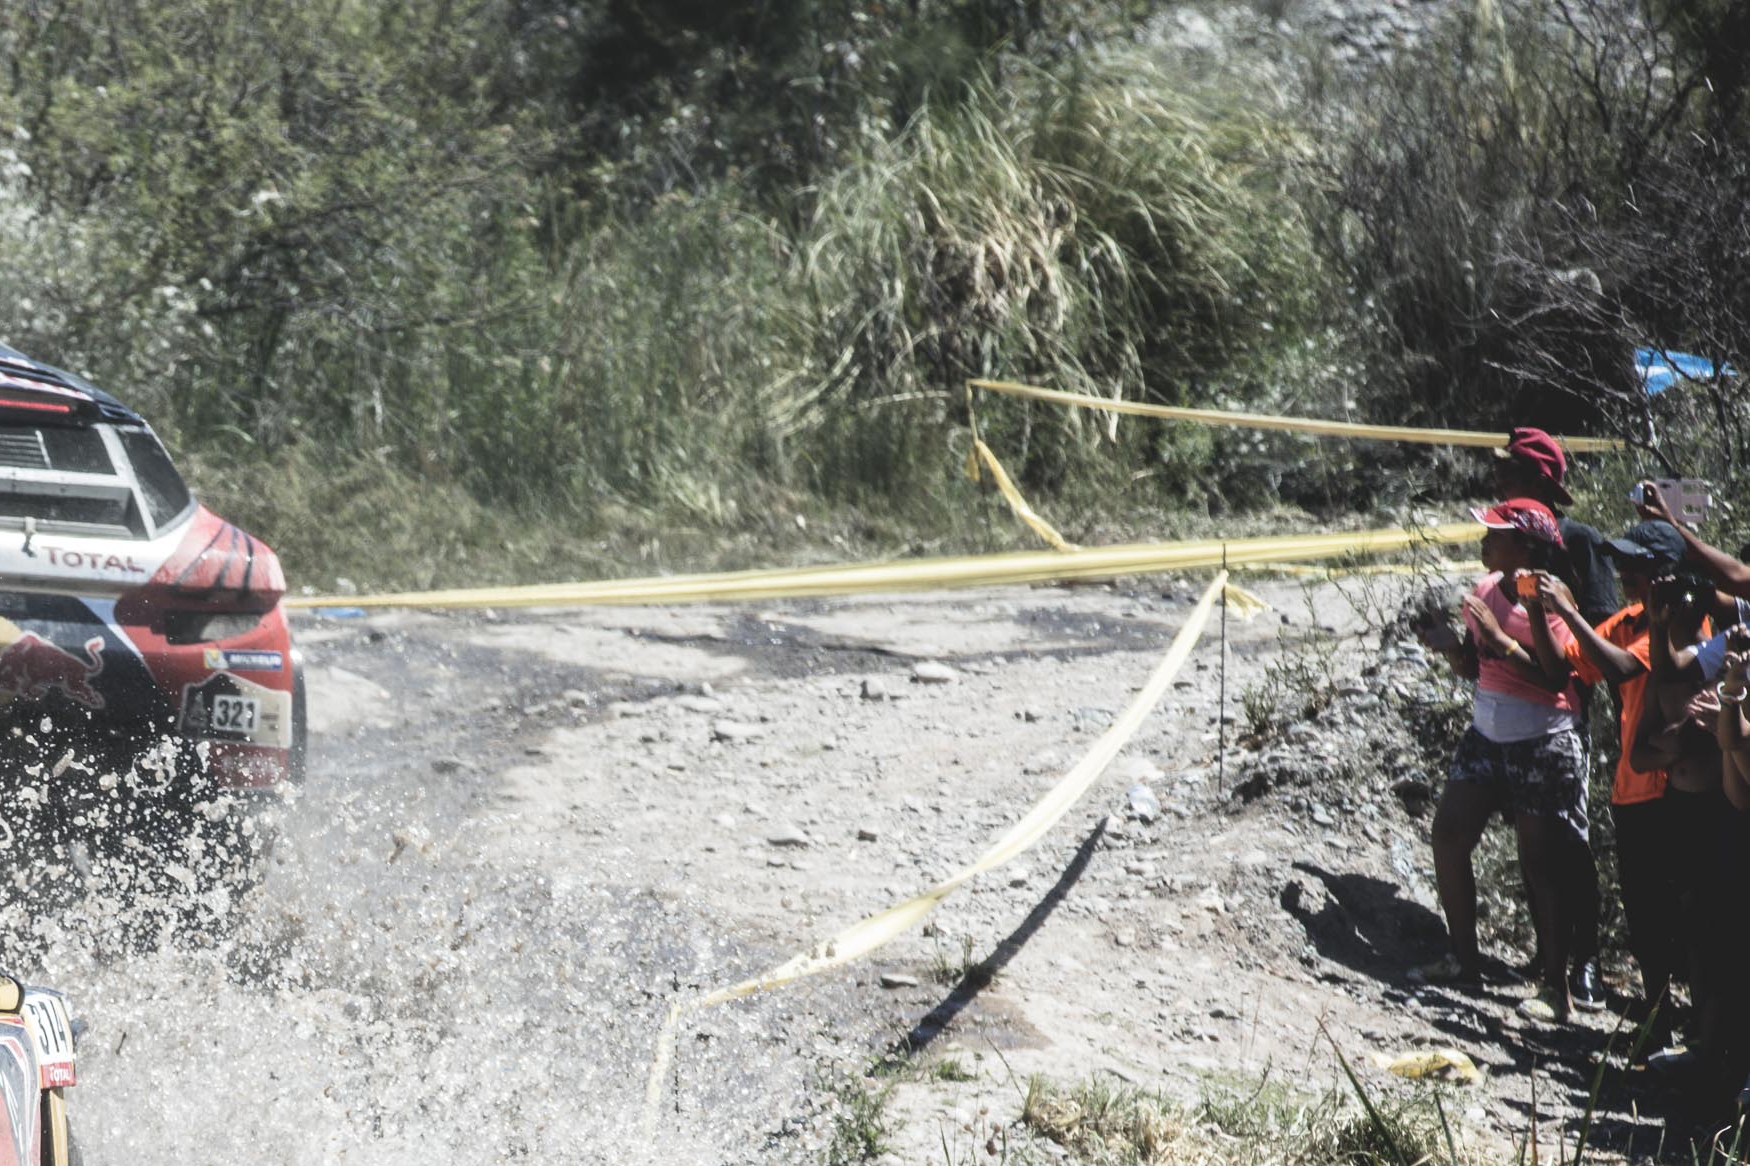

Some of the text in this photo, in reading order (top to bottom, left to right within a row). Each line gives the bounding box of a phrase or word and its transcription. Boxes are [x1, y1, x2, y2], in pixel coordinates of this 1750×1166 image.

[41, 546, 146, 573] TOTAL
[216, 700, 256, 729] 321
[26, 999, 68, 1056] 314
[50, 1064, 72, 1083] TOTAL
